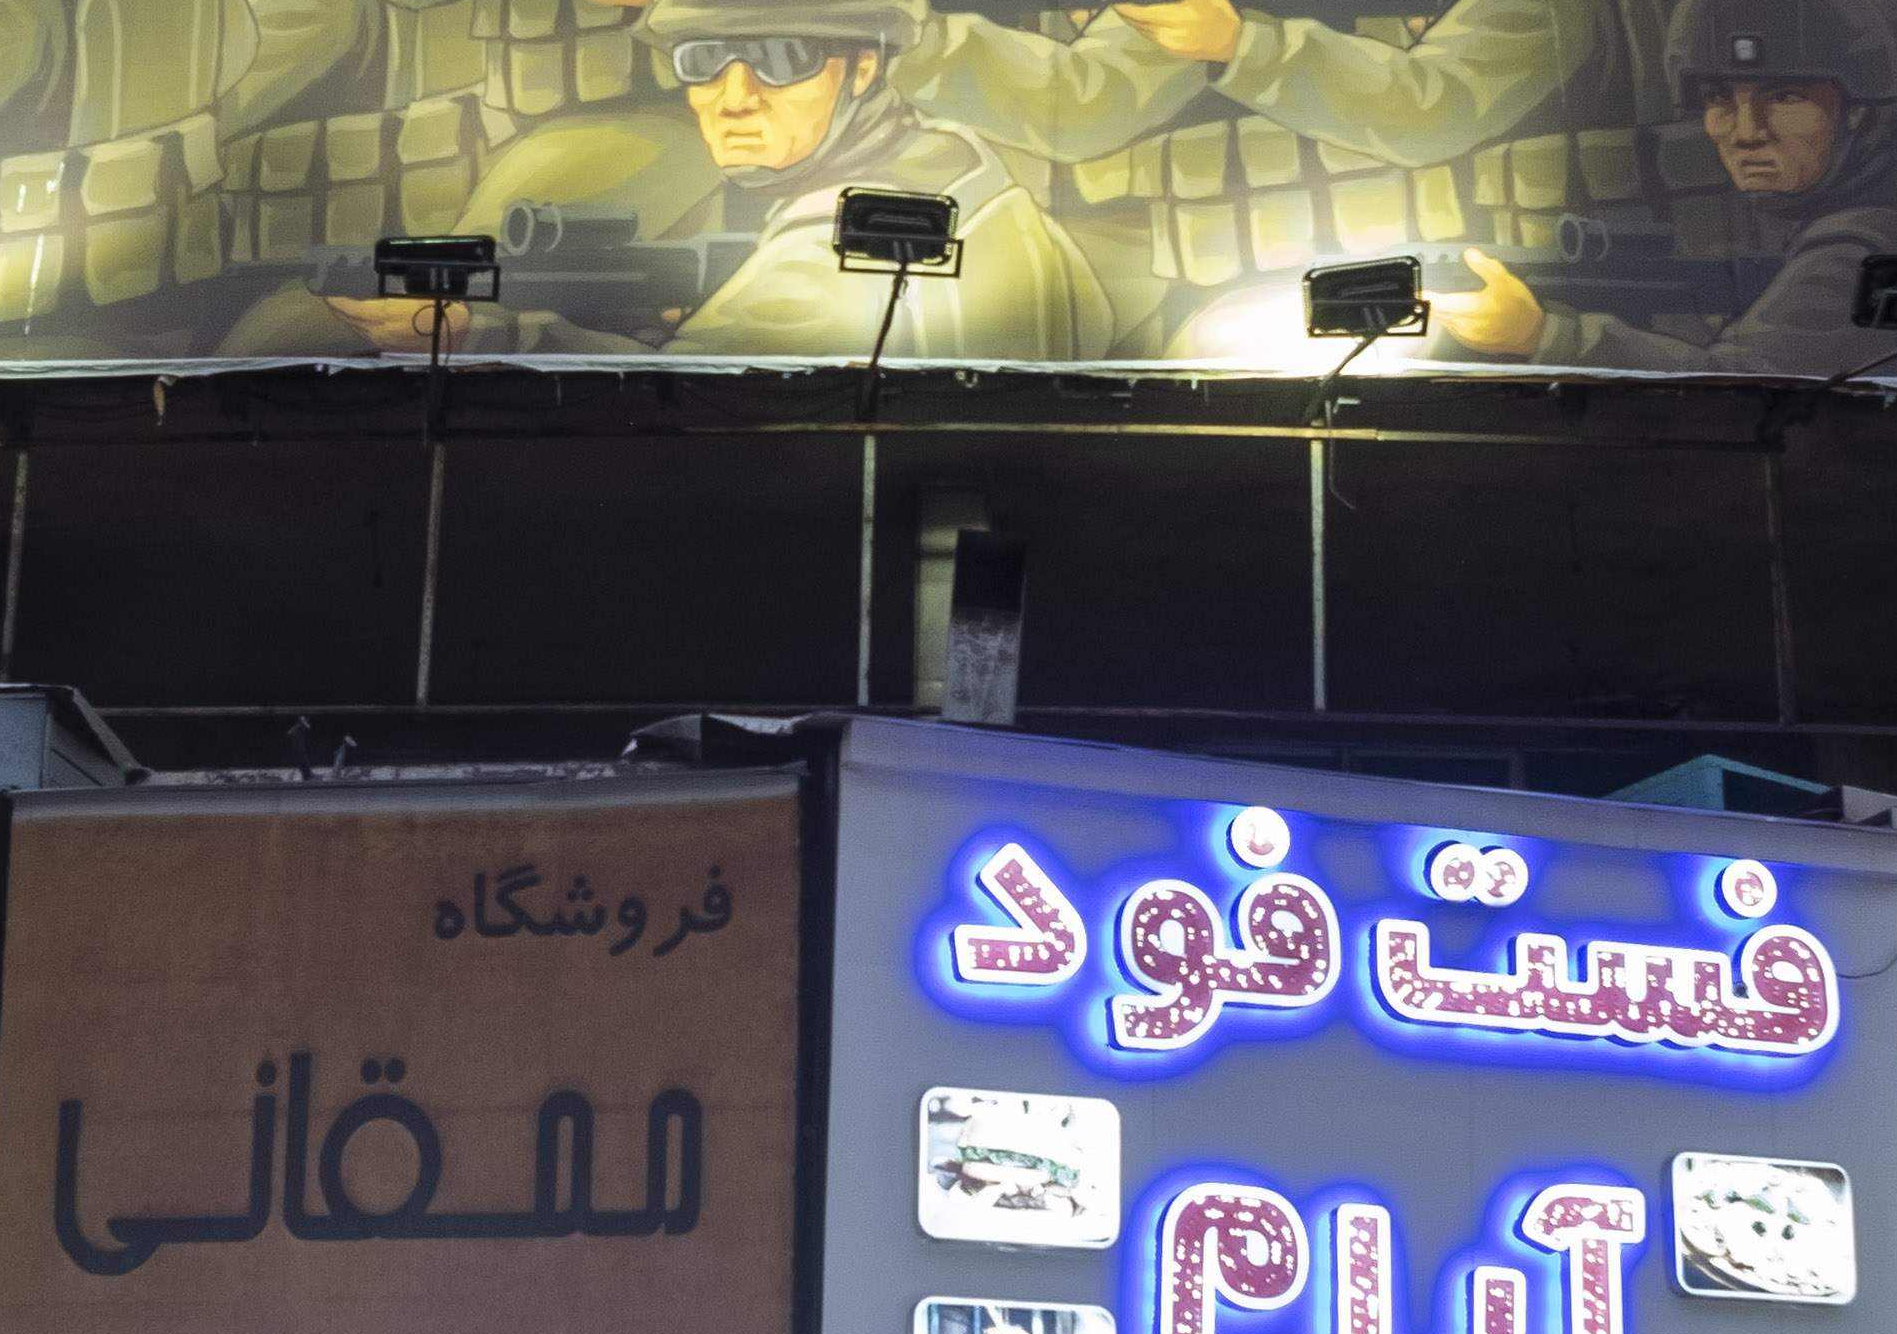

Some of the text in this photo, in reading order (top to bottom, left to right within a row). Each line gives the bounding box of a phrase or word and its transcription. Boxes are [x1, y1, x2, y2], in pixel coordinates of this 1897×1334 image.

[431, 867, 735, 959] فروشگاه
[953, 804, 1841, 1058] فست فود
[54, 1050, 704, 1277] ممقانی
